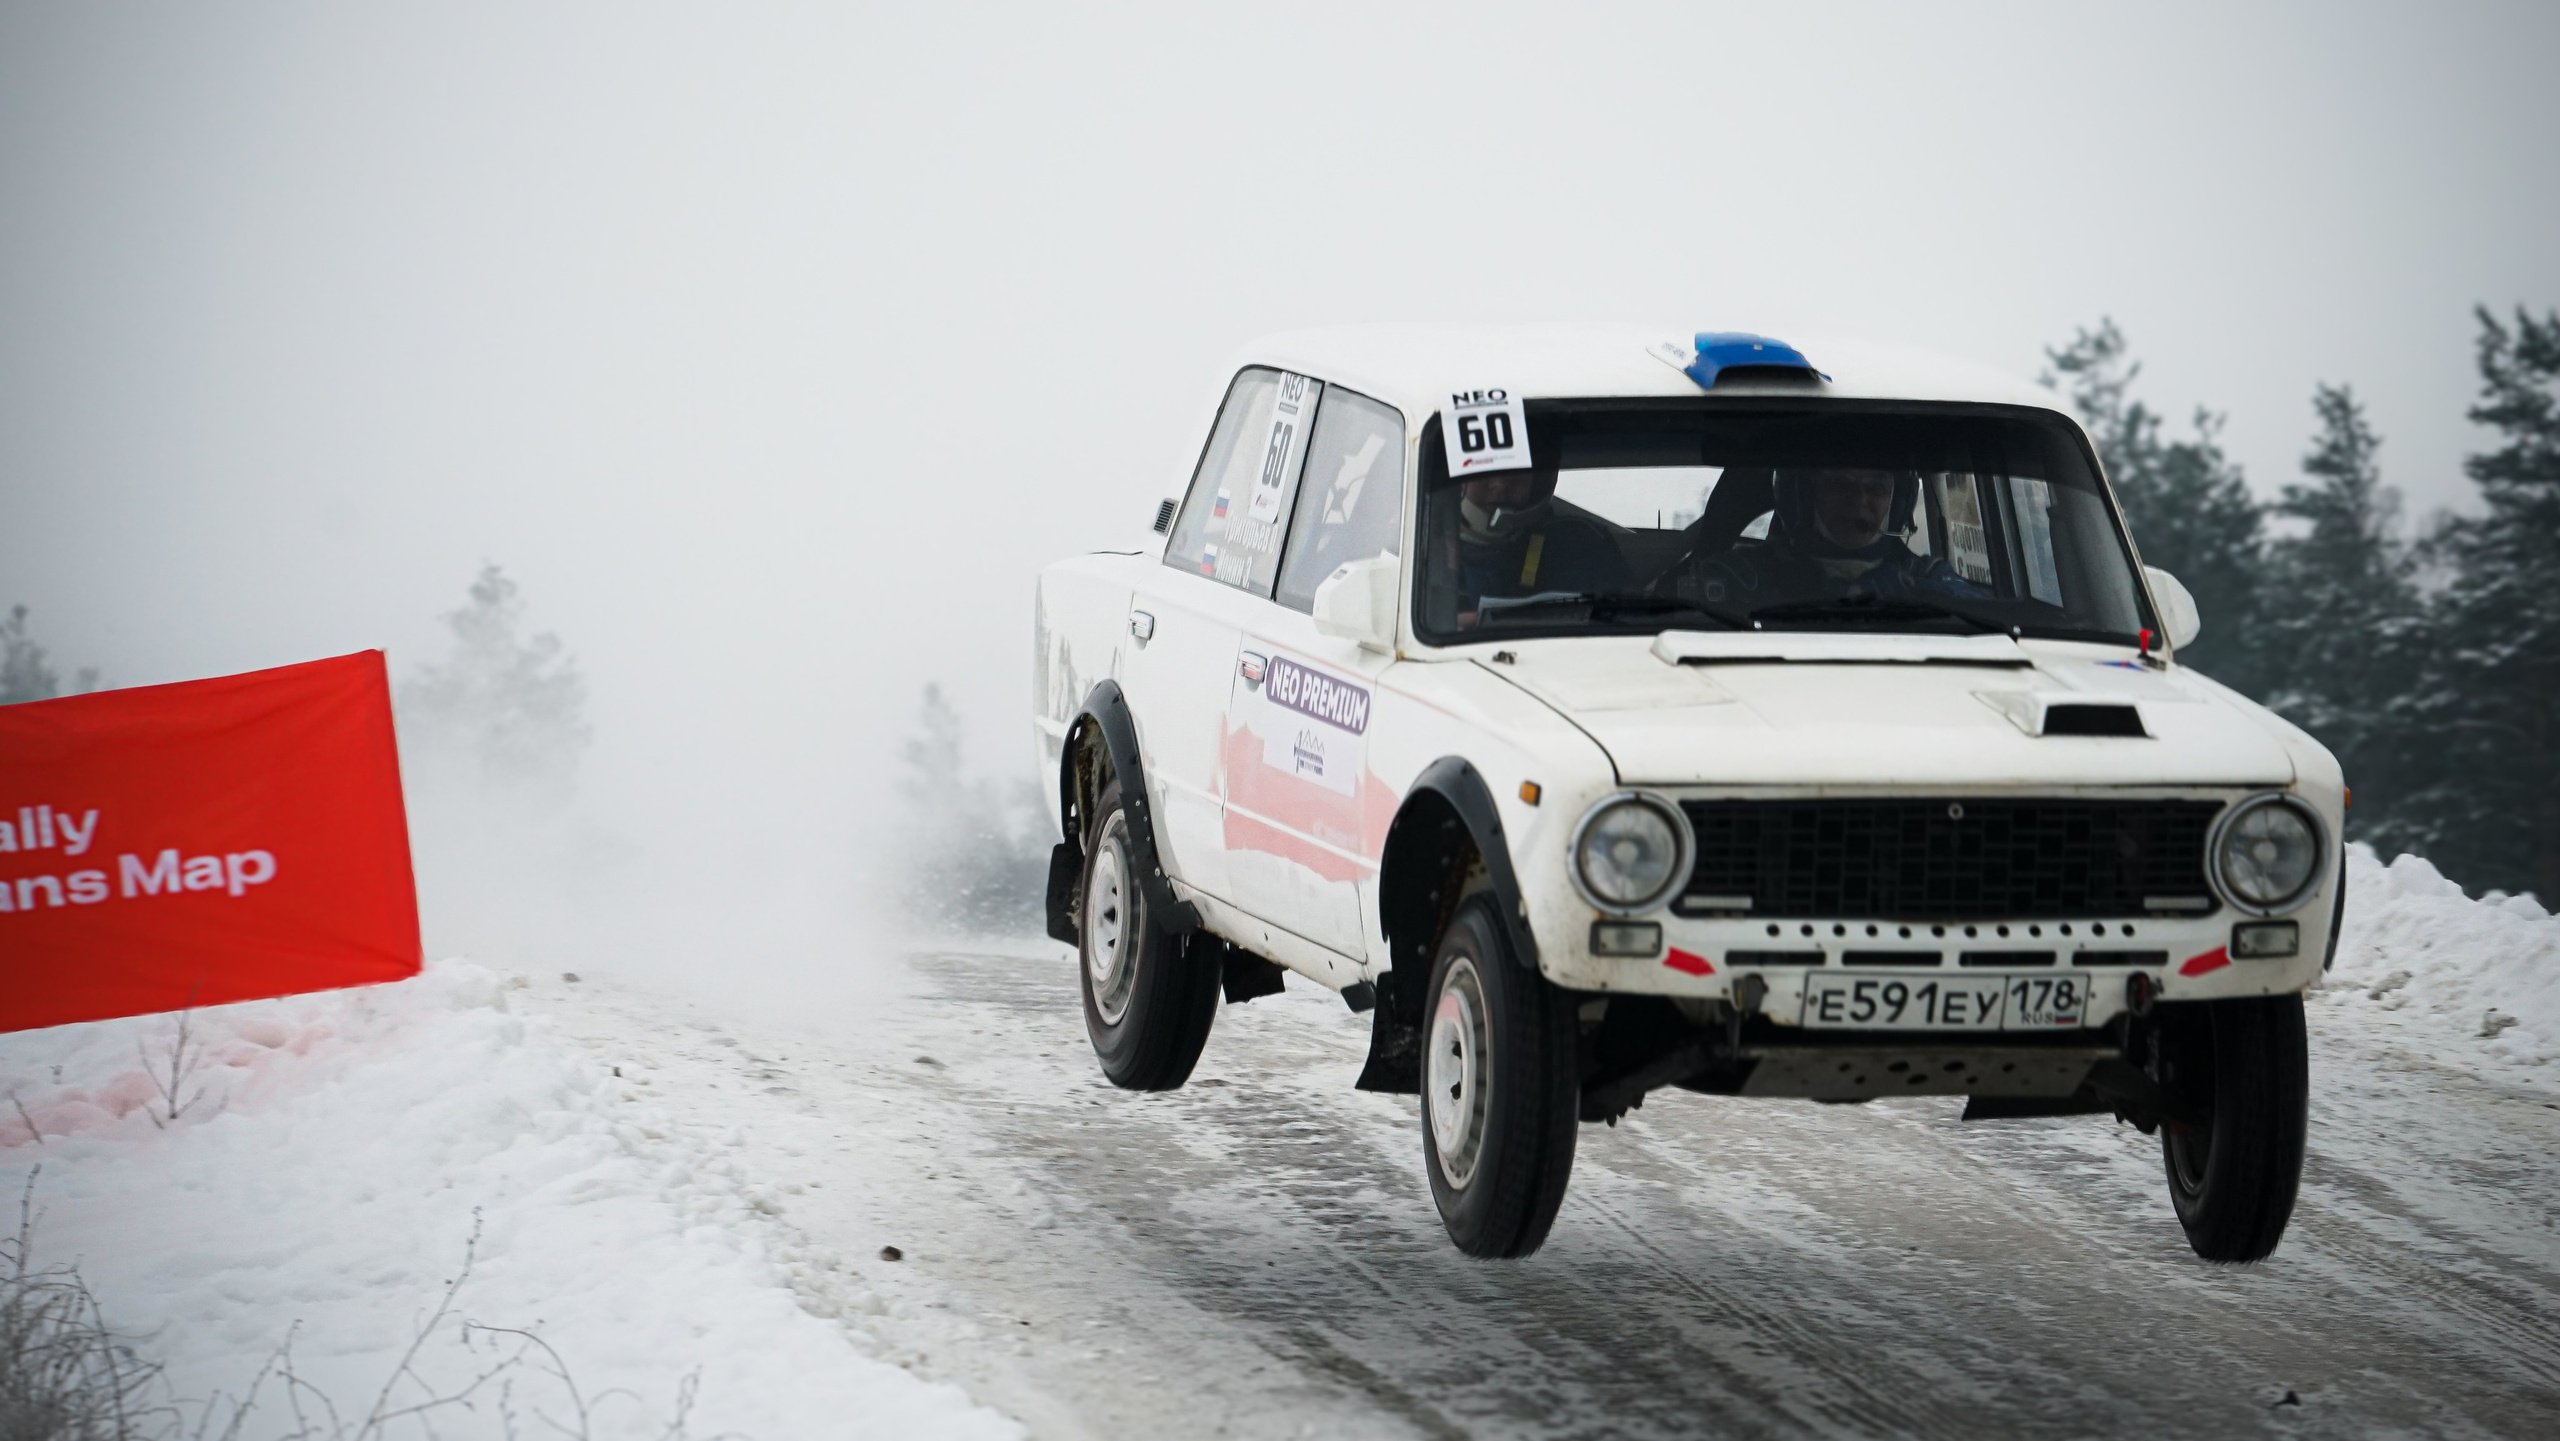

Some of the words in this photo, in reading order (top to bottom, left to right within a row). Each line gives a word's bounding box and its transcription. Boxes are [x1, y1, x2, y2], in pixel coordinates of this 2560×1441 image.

[1282, 373, 1304, 403] NEO
[1452, 389, 1507, 406] NEO
[1458, 412, 1514, 454] 60
[1262, 421, 1293, 489] 60
[1271, 662, 1300, 706] NEO
[1300, 673, 1368, 732] PREMIUM
[117, 848, 279, 898] Map
[2010, 979, 2075, 1012] 178
[2021, 1010, 2054, 1026] RUS
